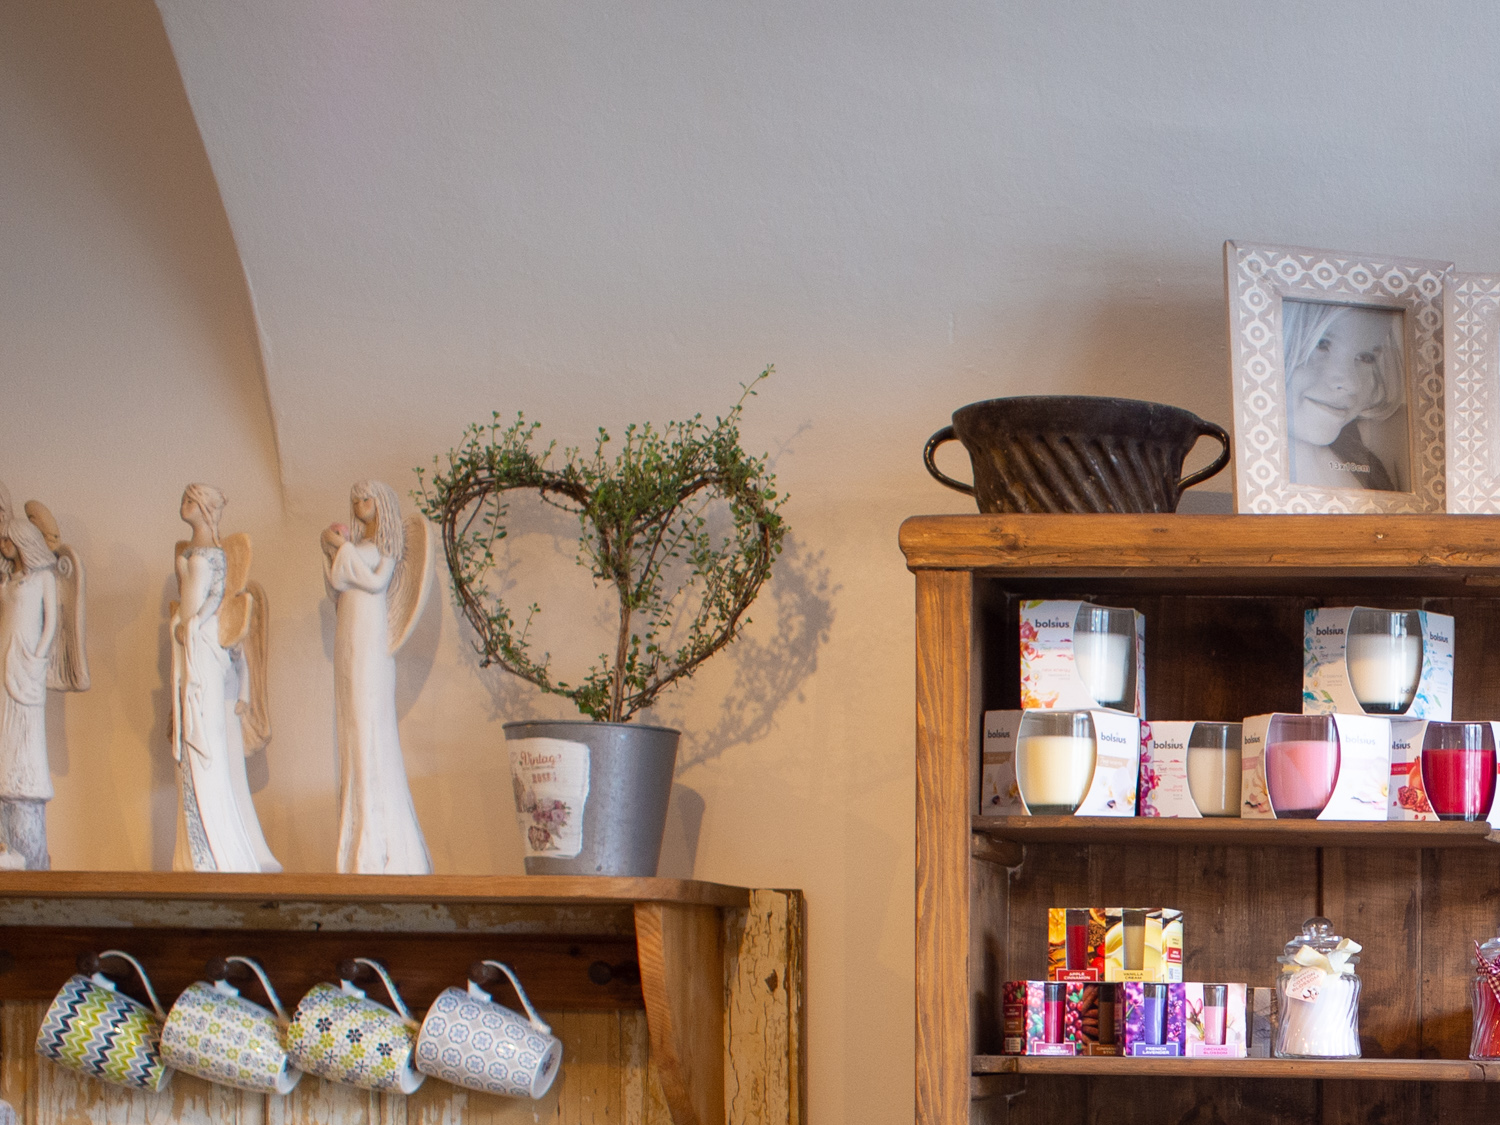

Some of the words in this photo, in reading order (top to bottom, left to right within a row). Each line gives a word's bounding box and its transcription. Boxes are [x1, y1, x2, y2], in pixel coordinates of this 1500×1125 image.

[1035, 618, 1069, 628] bolsius
[1316, 625, 1344, 635] bolsius
[1430, 632, 1449, 643] bolsius
[988, 728, 1010, 738] bolsius
[1101, 732, 1126, 744] bolsius
[1154, 739, 1183, 750] bolsius
[1244, 734, 1260, 745] bolsius
[1345, 735, 1376, 745] bolsius
[1392, 740, 1411, 750] lsius
